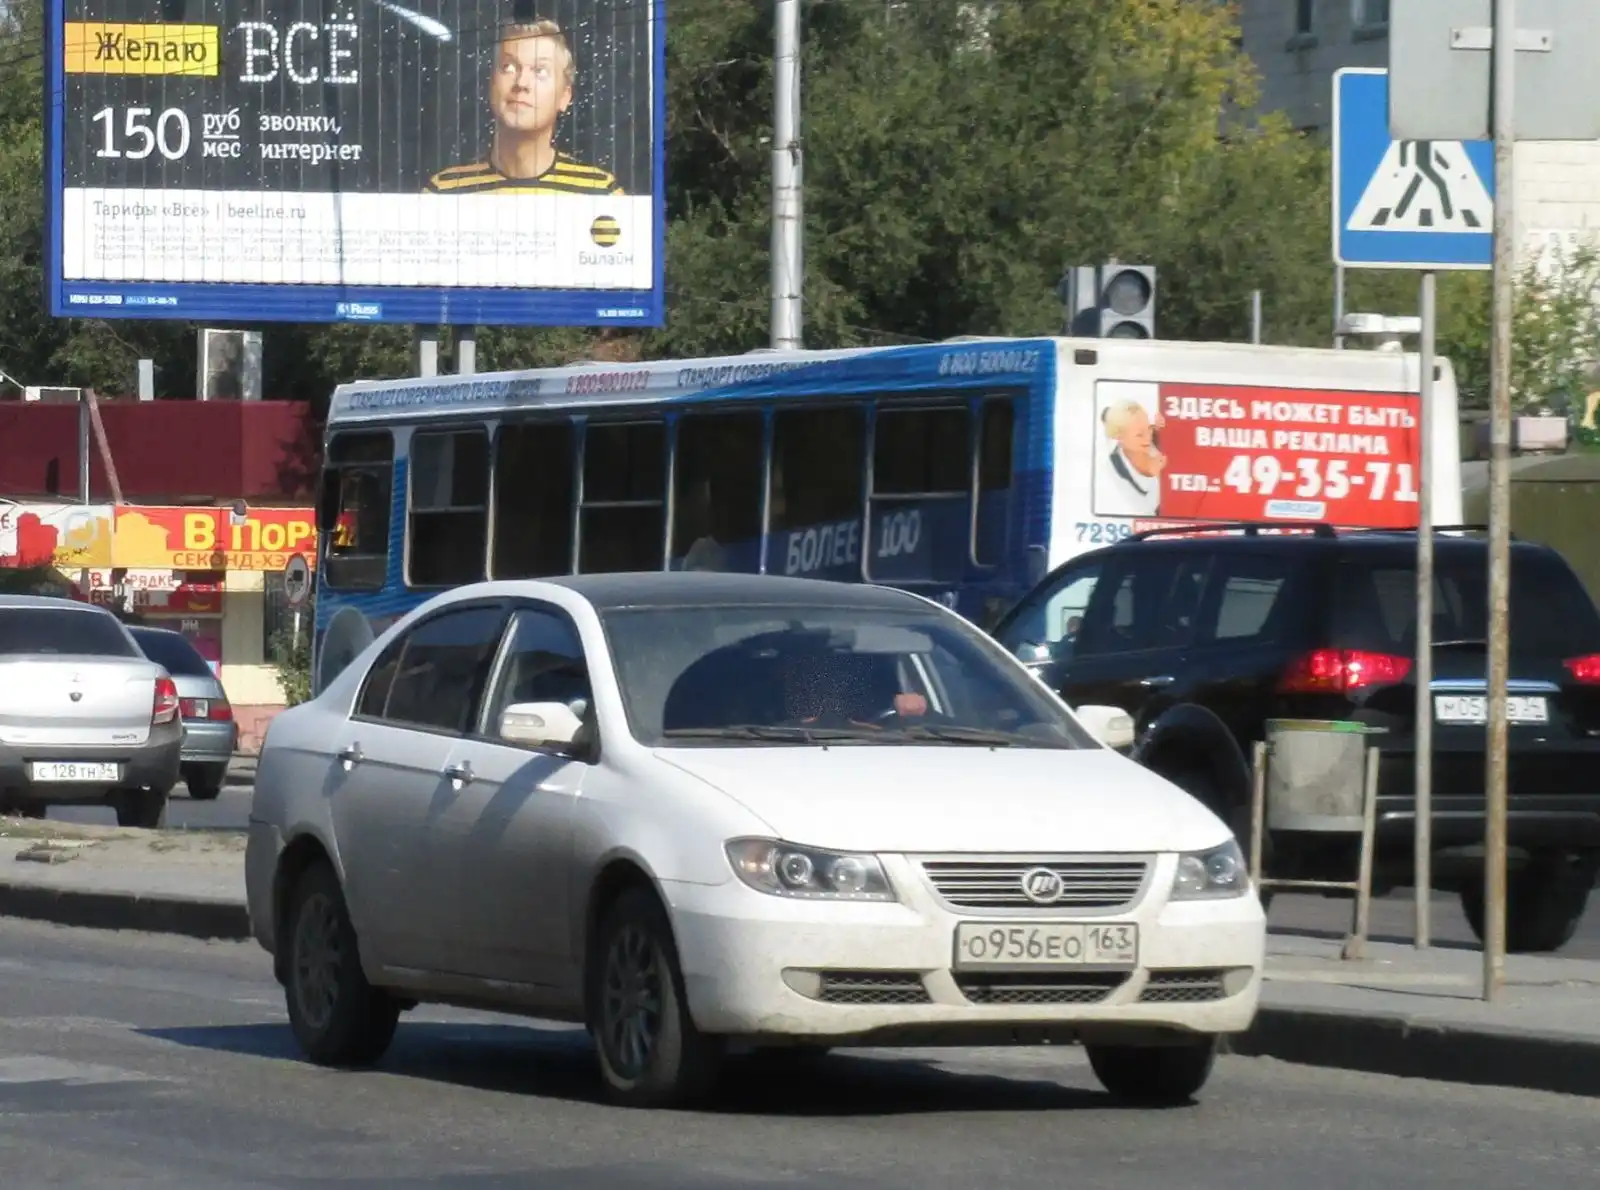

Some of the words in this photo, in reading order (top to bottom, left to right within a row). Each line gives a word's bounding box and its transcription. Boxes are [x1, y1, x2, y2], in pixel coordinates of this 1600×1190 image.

[95, 31, 207, 62] Желаю
[237, 13, 359, 85] ВСЁ
[91, 107, 190, 160] 150
[203, 108, 240, 134] руб
[259, 114, 342, 134] звонки,
[203, 140, 240, 158] мес
[260, 143, 361, 165] интернет
[94, 201, 156, 222] Тарифы
[228, 203, 306, 219] beeline.ru
[1165, 396, 1244, 419] ЗДЕСЬ
[1251, 400, 1341, 424] МОЖЕТ
[1347, 406, 1416, 428] БЫТЬ
[1196, 426, 1268, 449] ВАША
[1273, 431, 1389, 455] РЕКЛАМА
[1223, 455, 1418, 502] 49-35-71
[185, 513, 215, 550] В
[786, 518, 859, 575] БОЛЕЕ
[878, 510, 920, 557] 100
[1075, 523, 1131, 542] 7239
[1089, 928, 1132, 949] 163
